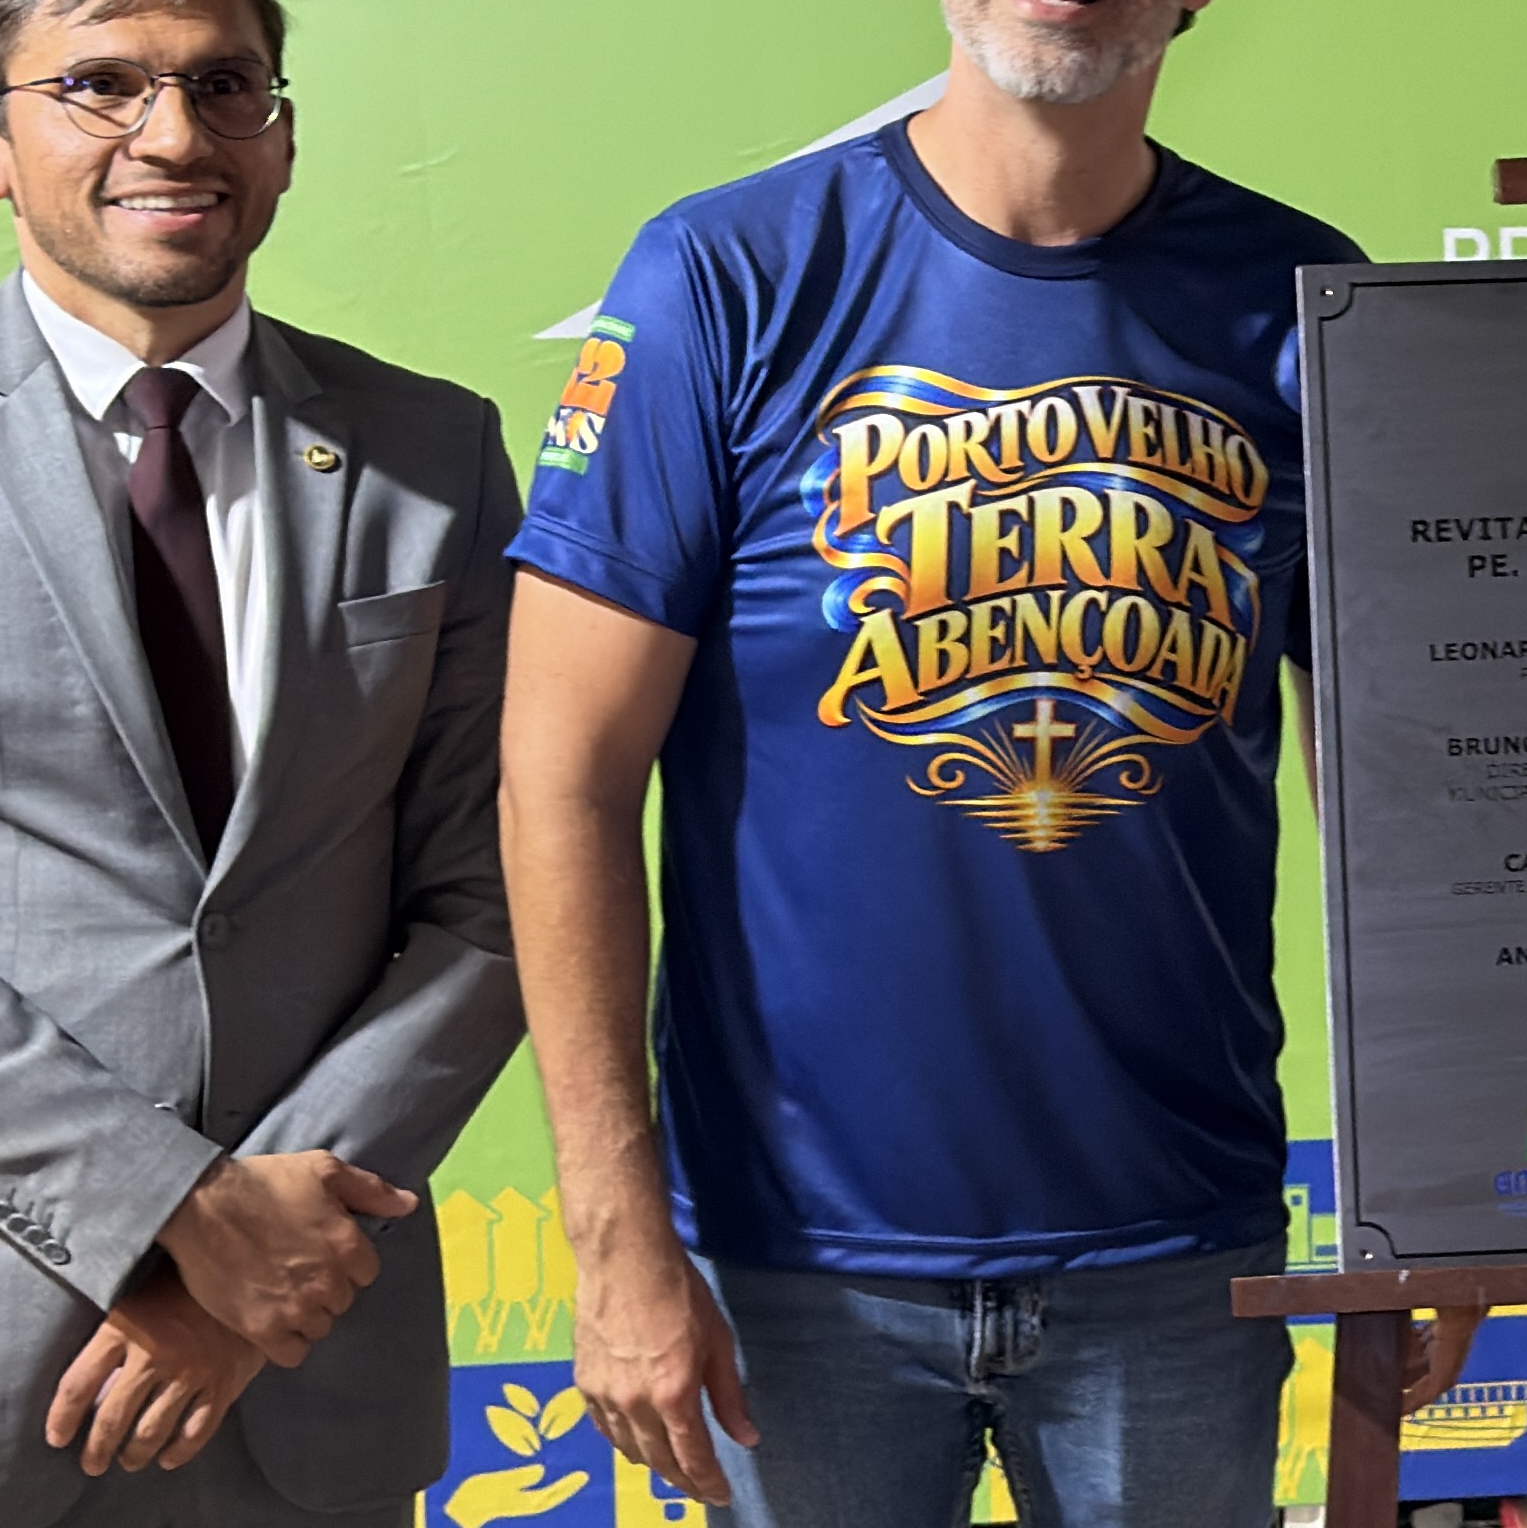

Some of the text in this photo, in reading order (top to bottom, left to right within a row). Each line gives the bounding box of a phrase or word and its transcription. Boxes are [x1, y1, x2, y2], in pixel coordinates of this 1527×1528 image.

[833, 385, 1269, 537] PORTO VELHO
[876, 480, 1235, 631] TERRA
[1468, 553, 1519, 578] PE.
[817, 589, 1250, 727] ABENÇOADA
